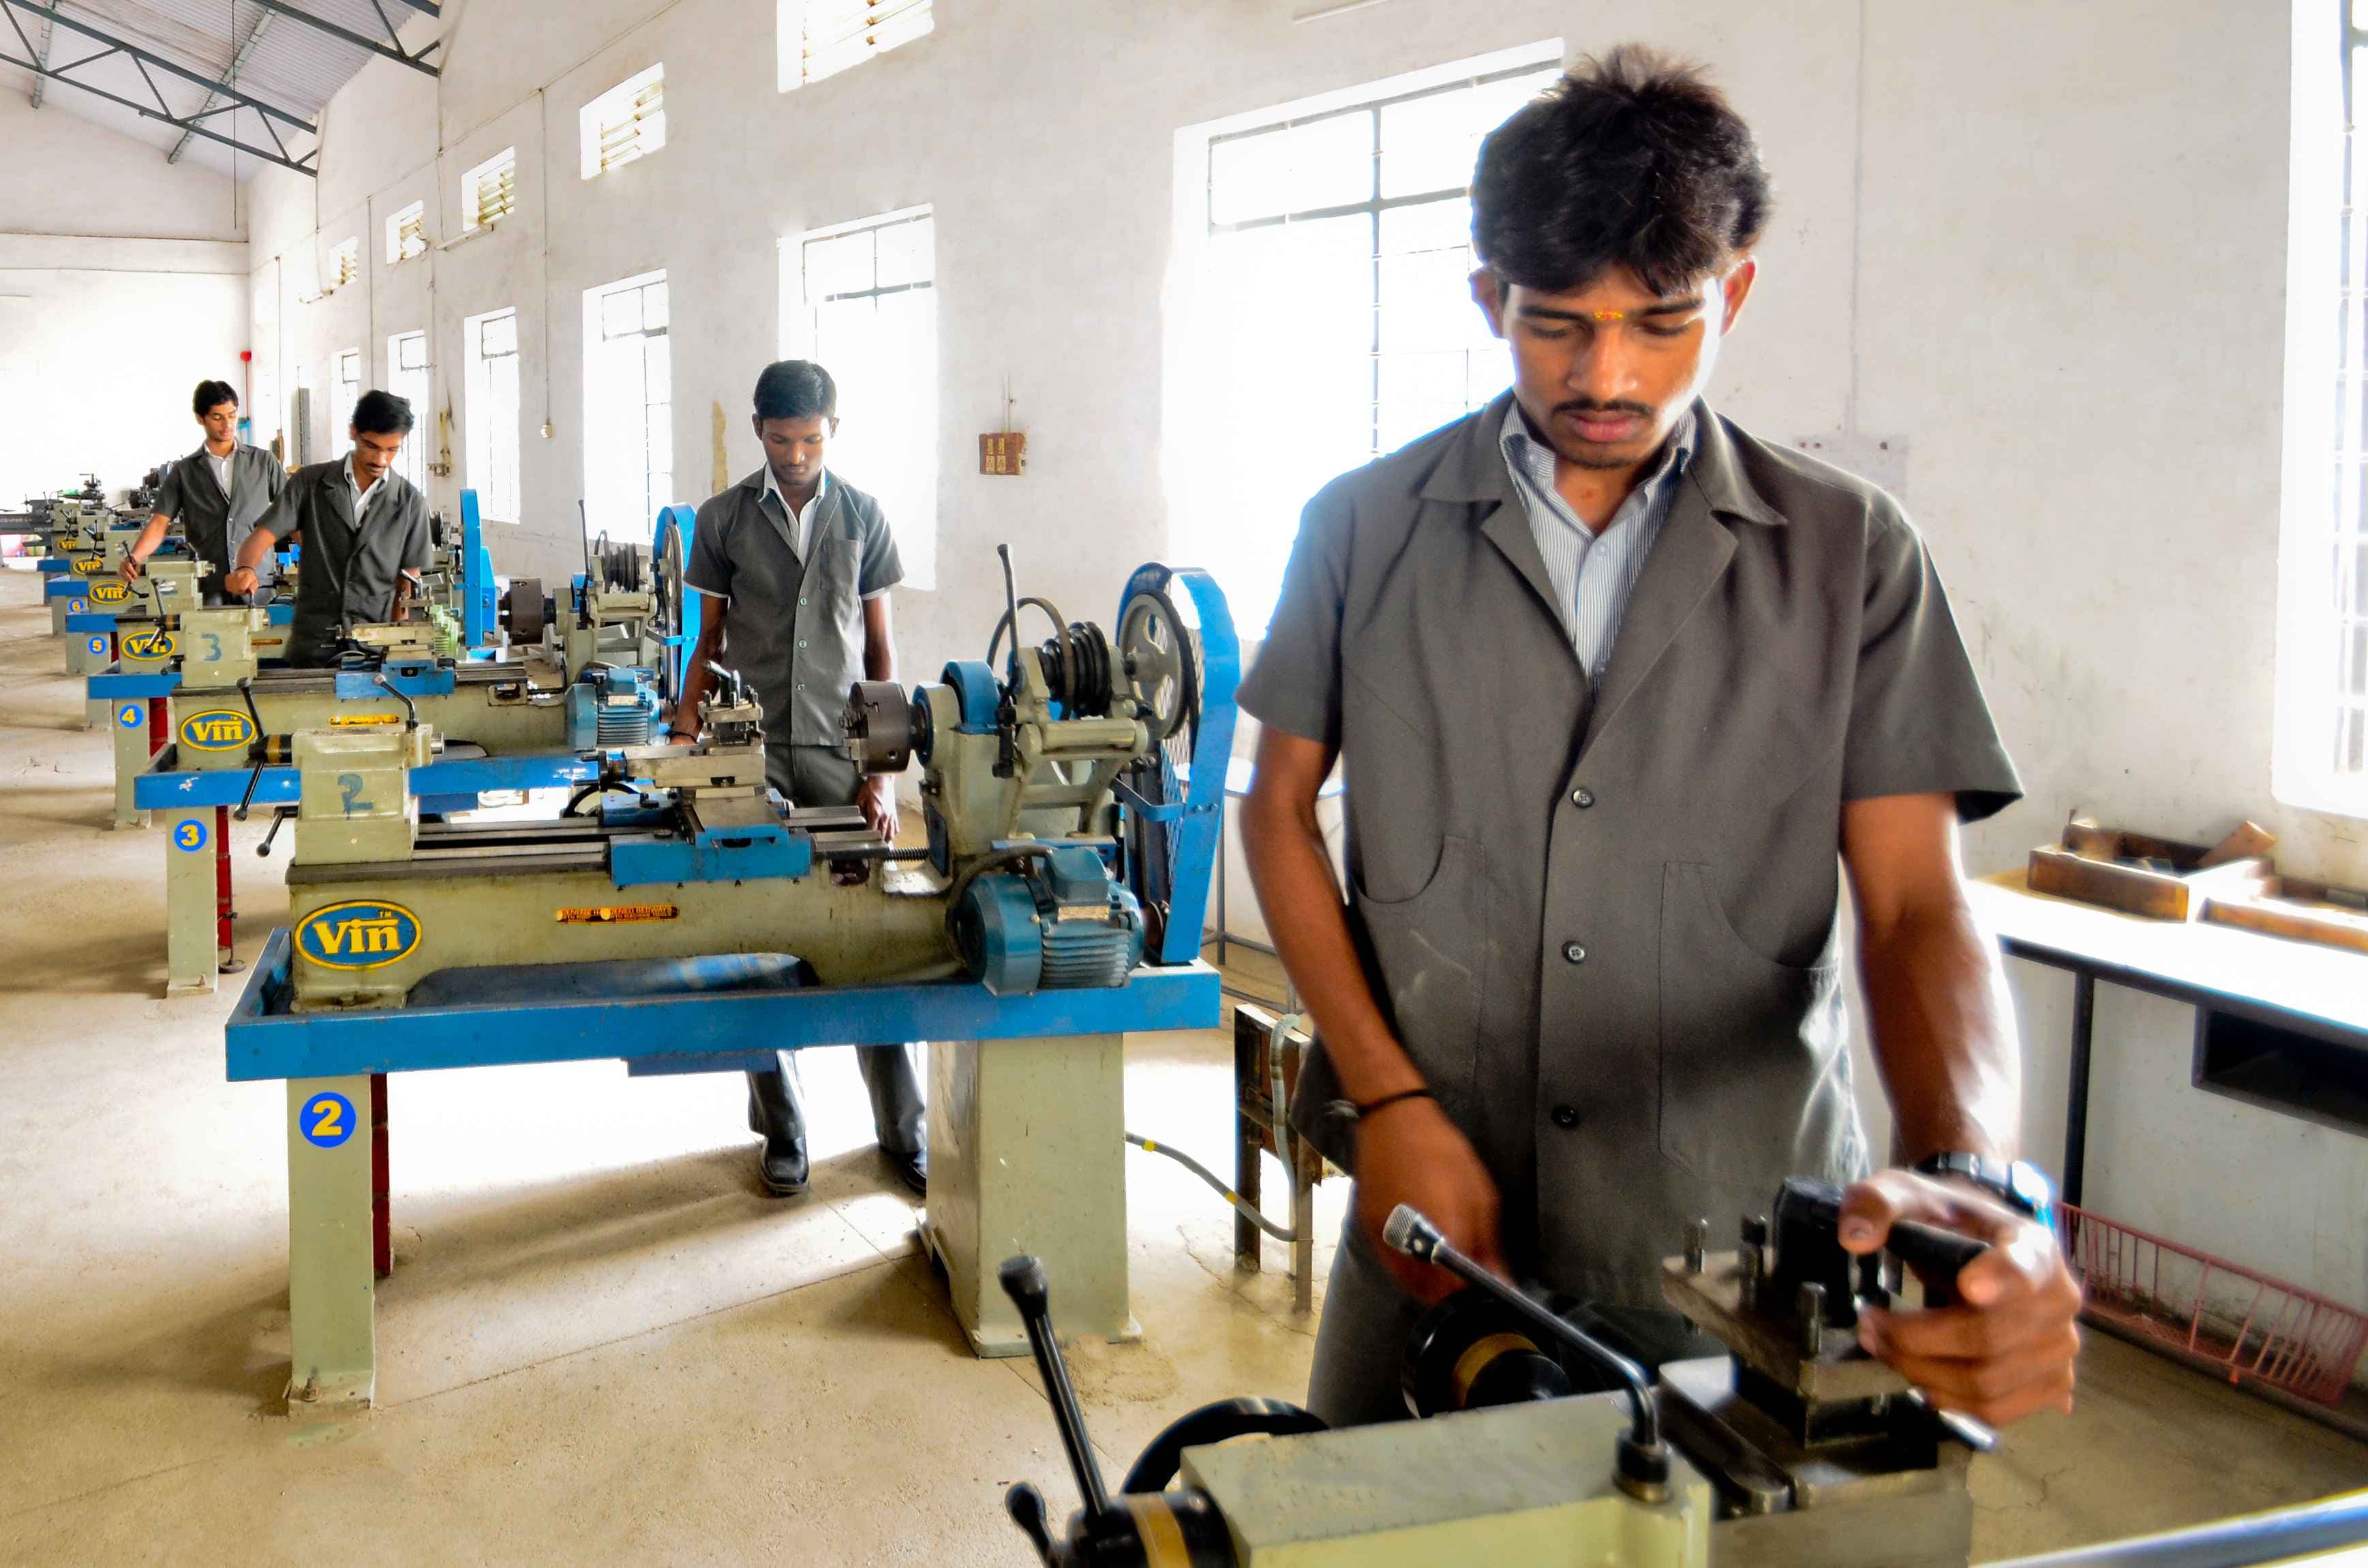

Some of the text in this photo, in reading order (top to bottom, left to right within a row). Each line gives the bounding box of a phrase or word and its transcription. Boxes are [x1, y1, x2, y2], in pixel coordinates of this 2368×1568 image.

[95, 586, 123, 599] Vin
[93, 640, 102, 651] 5
[200, 632, 222, 661] 3
[122, 708, 136, 724] 4
[191, 720, 243, 742] Vin
[337, 774, 374, 818] 2
[181, 825, 199, 846] 3
[312, 919, 401, 955] Vin
[312, 1099, 343, 1137] 2
